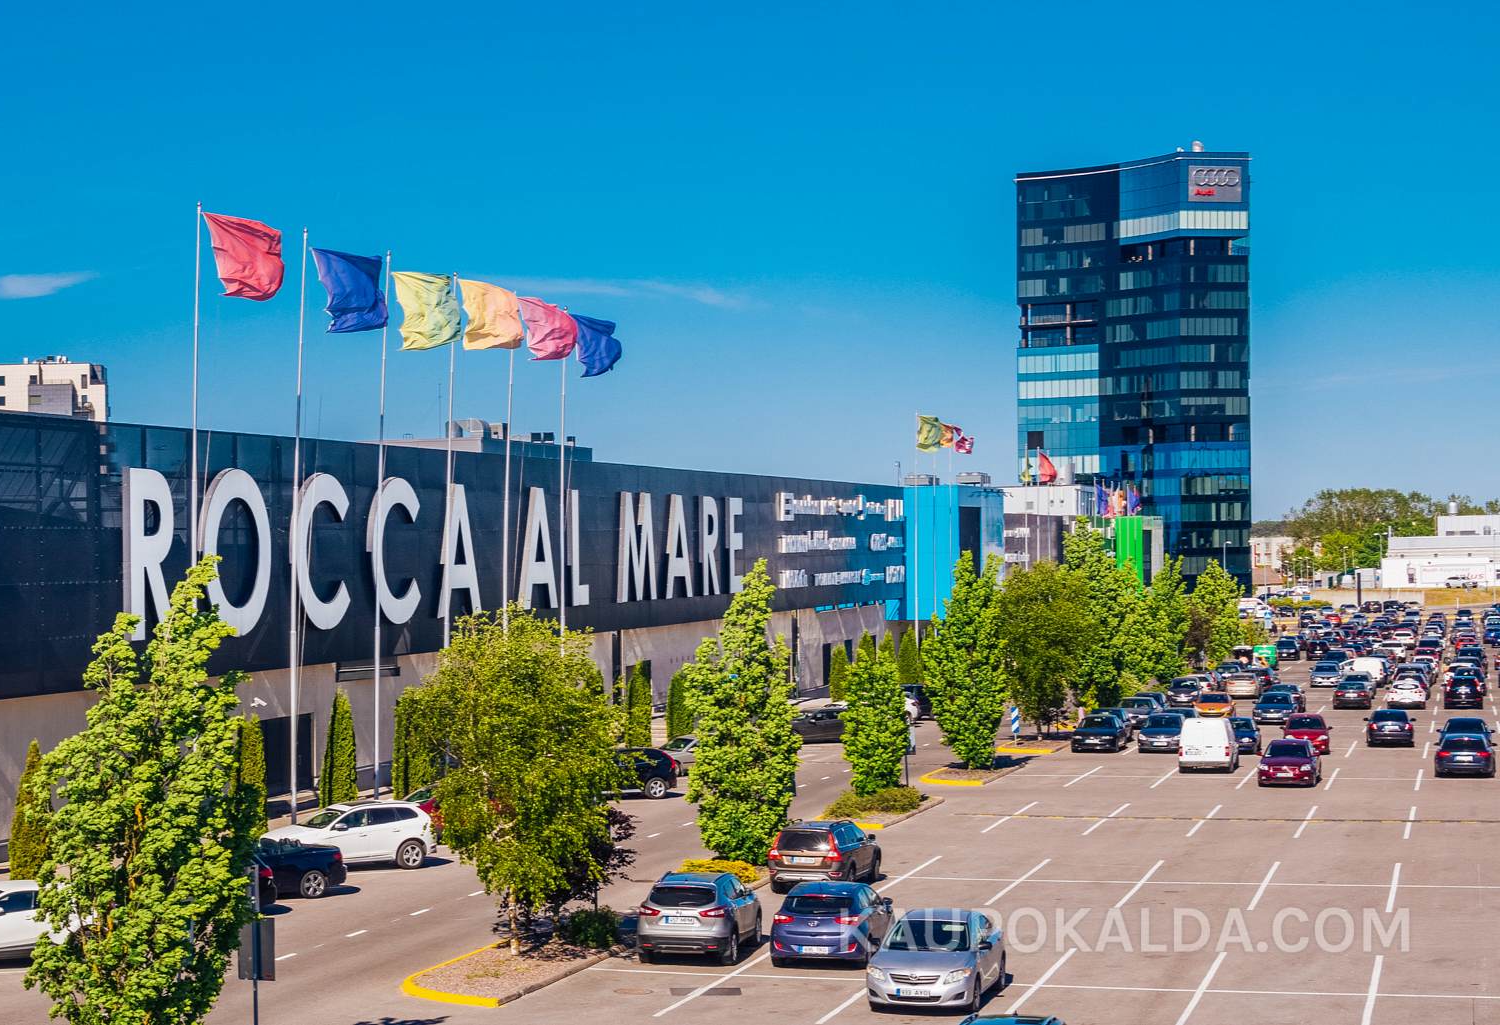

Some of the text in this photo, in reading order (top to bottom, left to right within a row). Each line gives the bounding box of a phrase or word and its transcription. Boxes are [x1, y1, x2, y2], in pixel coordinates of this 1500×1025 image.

[1193, 187, 1217, 197] Audi
[122, 467, 743, 641] ROCCA AL MARE
